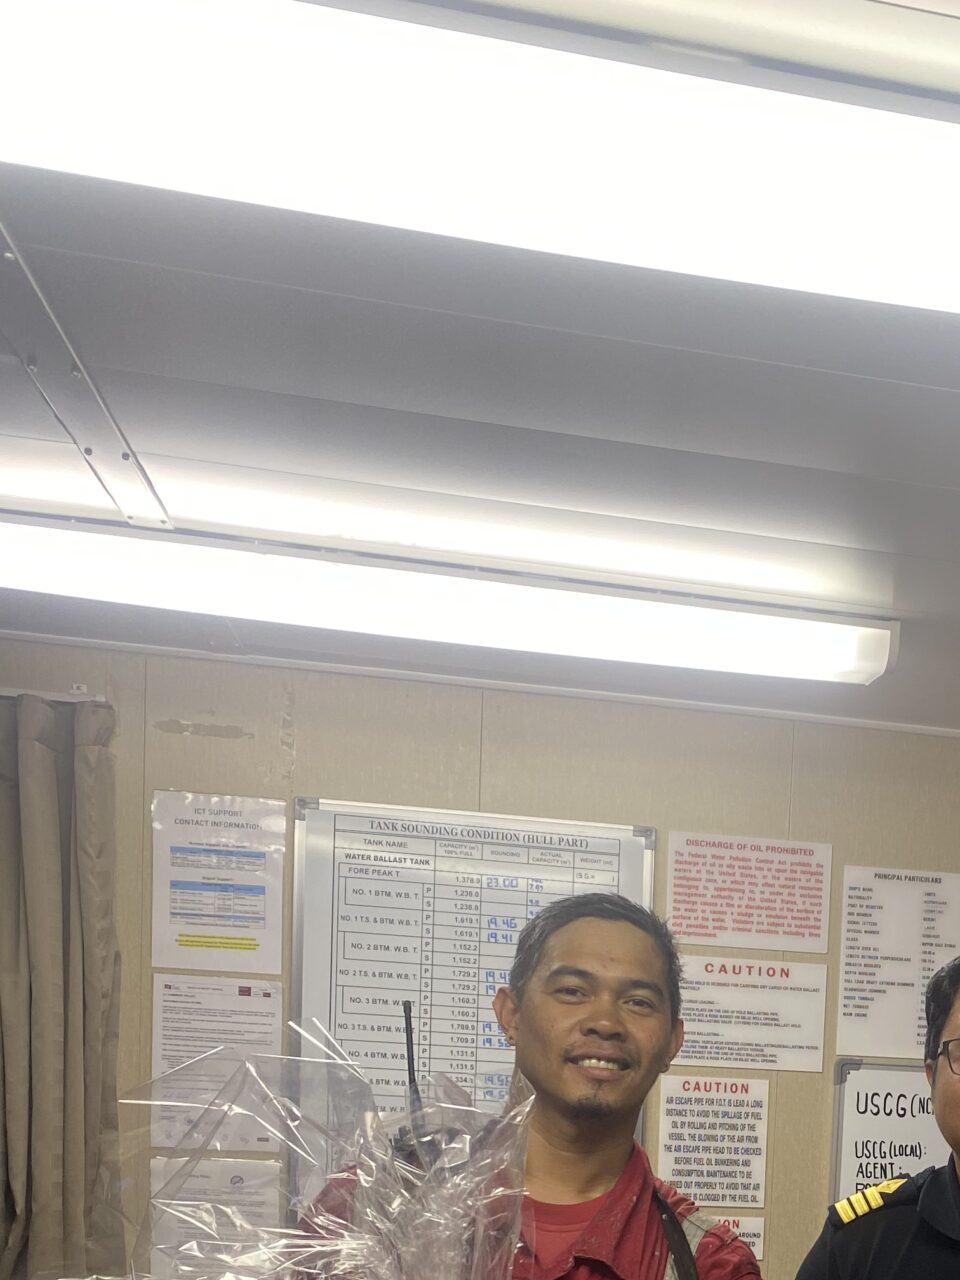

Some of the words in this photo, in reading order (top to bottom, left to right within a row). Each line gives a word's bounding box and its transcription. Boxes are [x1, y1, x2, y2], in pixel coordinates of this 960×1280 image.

[194, 807, 206, 815] ICT
[208, 809, 243, 818] SUPPORT
[174, 818, 209, 827] CONTACT
[368, 820, 399, 832] TANK
[401, 823, 458, 837] SOUNDING
[460, 829, 521, 842] CONDITION
[523, 834, 557, 846] (HULL
[559, 837, 589, 849] PART)
[363, 838, 384, 846] TANK
[386, 840, 408, 848] NAME
[686, 838, 734, 850] DISCHARGE
[737, 843, 748, 851] OF
[750, 844, 763, 852] OIL
[765, 845, 815, 857] PROHIBITED
[344, 853, 372, 861] WATER
[373, 854, 407, 864] BALLAST
[348, 867, 369, 875] FORE
[874, 873, 903, 882] PRINCIPAL
[904, 875, 942, 884] PARTICULARS
[704, 963, 790, 979] CAUTION
[682, 1081, 749, 1094] CAUTION
[666, 1096, 674, 1104] AIR
[675, 1097, 693, 1105] ESCAPE
[694, 1098, 704, 1106] PIPE
[705, 1098, 714, 1106] FOR
[727, 1099, 732, 1107] IS
[750, 1100, 763, 1108] LONG
[666, 1108, 688, 1117] DISTANCE
[689, 1109, 695, 1117] TO
[696, 1110, 710, 1118] AVOID
[711, 1110, 720, 1118] THE
[721, 1111, 742, 1119] SPILLAGE
[751, 1112, 762, 1120] FUEL
[680, 1121, 686, 1129] BY
[688, 1122, 707, 1130] ROLLING
[708, 1122, 717, 1130] AND
[719, 1123, 739, 1131] PITCHING
[740, 1123, 746, 1131] OF
[747, 1124, 756, 1132] THE
[688, 1133, 696, 1142] THE
[698, 1134, 718, 1142] BLOWING
[727, 1135, 736, 1143] THE
[745, 1136, 758, 1144] FROM
[664, 1144, 672, 1152] THE
[683, 1145, 700, 1153] ESCAPE
[702, 1146, 711, 1154] PIPE
[713, 1146, 725, 1154] HEAD
[734, 1147, 739, 1155] BE
[741, 1147, 762, 1156] CHECKED
[674, 1156, 692, 1165] BEFORE
[694, 1158, 704, 1166] FUEL
[714, 1158, 740, 1166] BUNKERING
[741, 1159, 751, 1167] AND
[706, 1170, 737, 1178] MAINTENANCE
[746, 1171, 752, 1179] BE
[684, 1181, 693, 1189] OUT
[694, 1182, 717, 1190] PROPERLY
[718, 1182, 724, 1190] TO
[725, 1182, 739, 1190] AVOID
[752, 1183, 760, 1191] AIR
[693, 1193, 697, 1201] IS
[698, 1193, 720, 1202] CLOGGED
[721, 1194, 727, 1202] BY
[728, 1194, 737, 1202] THE
